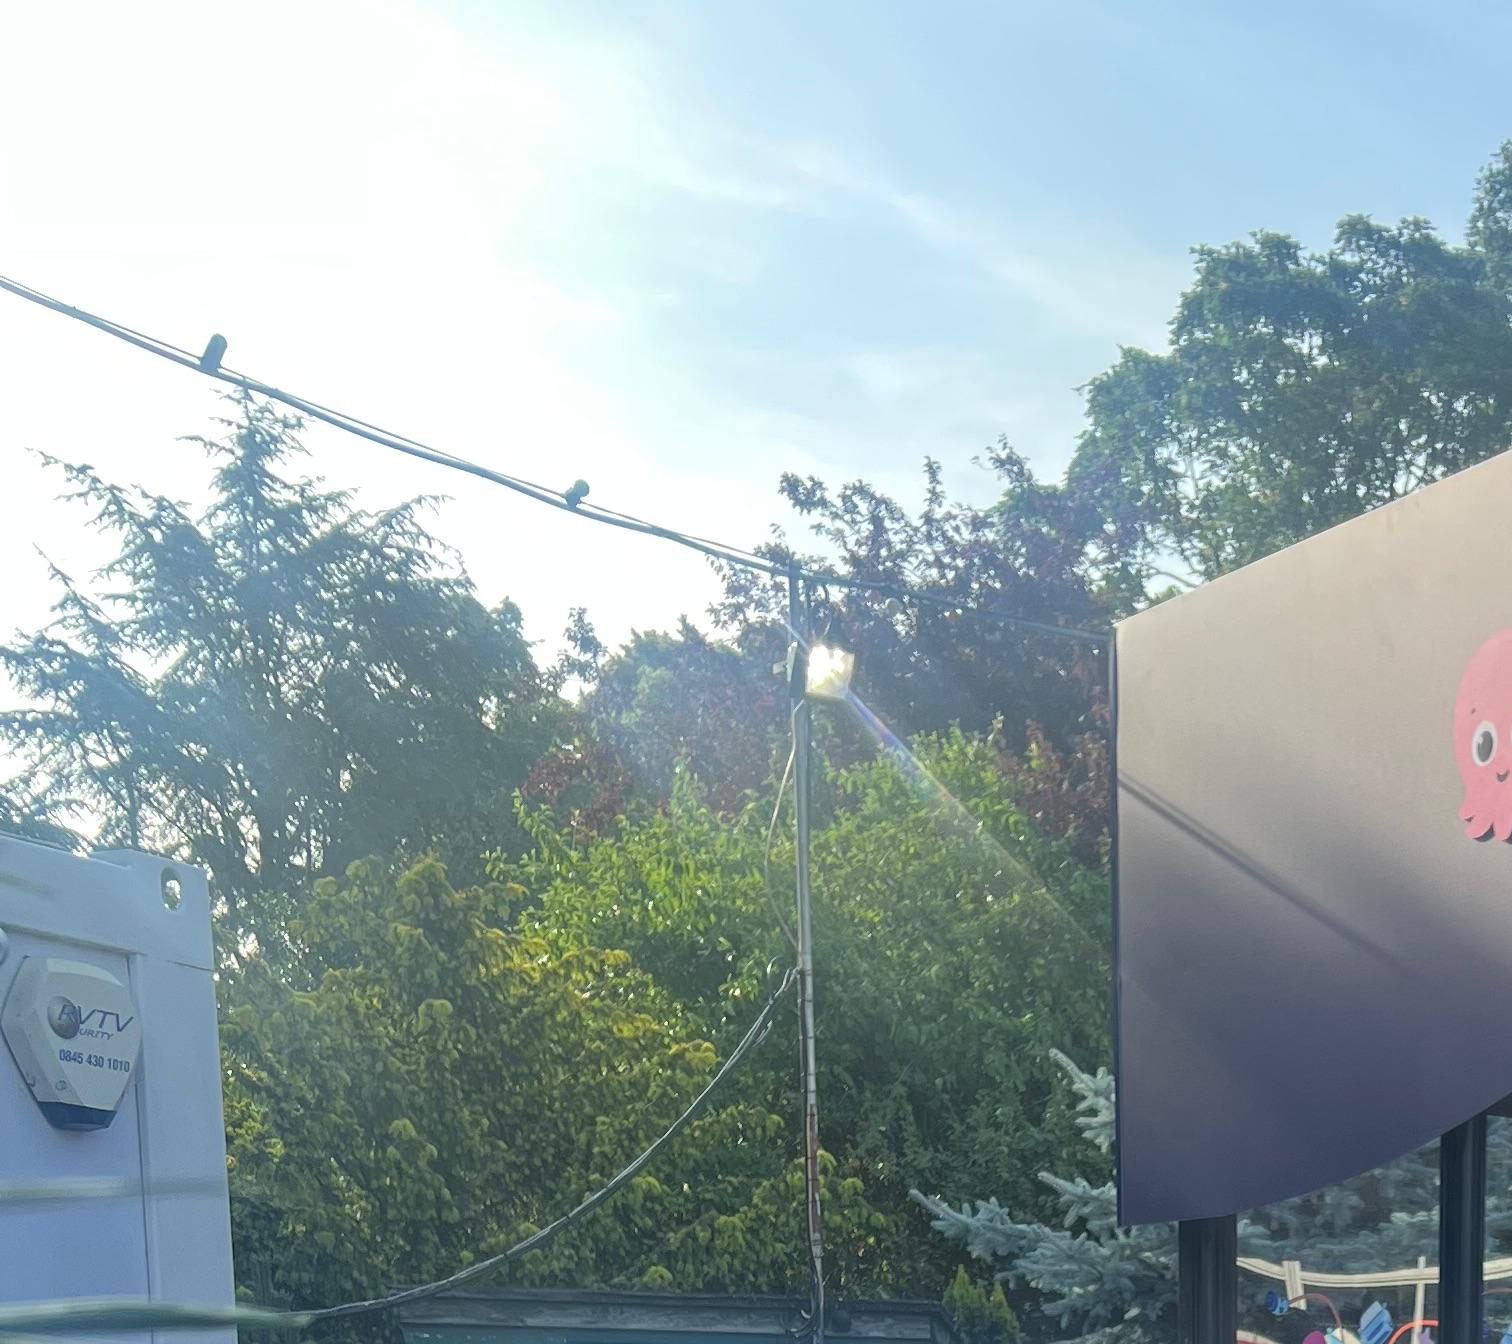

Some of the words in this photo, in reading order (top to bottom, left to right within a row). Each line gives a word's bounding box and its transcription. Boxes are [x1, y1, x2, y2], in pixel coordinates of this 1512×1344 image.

[59, 1048, 84, 1065] 0845
[86, 1053, 104, 1068] 430
[107, 1058, 130, 1073] 1010
